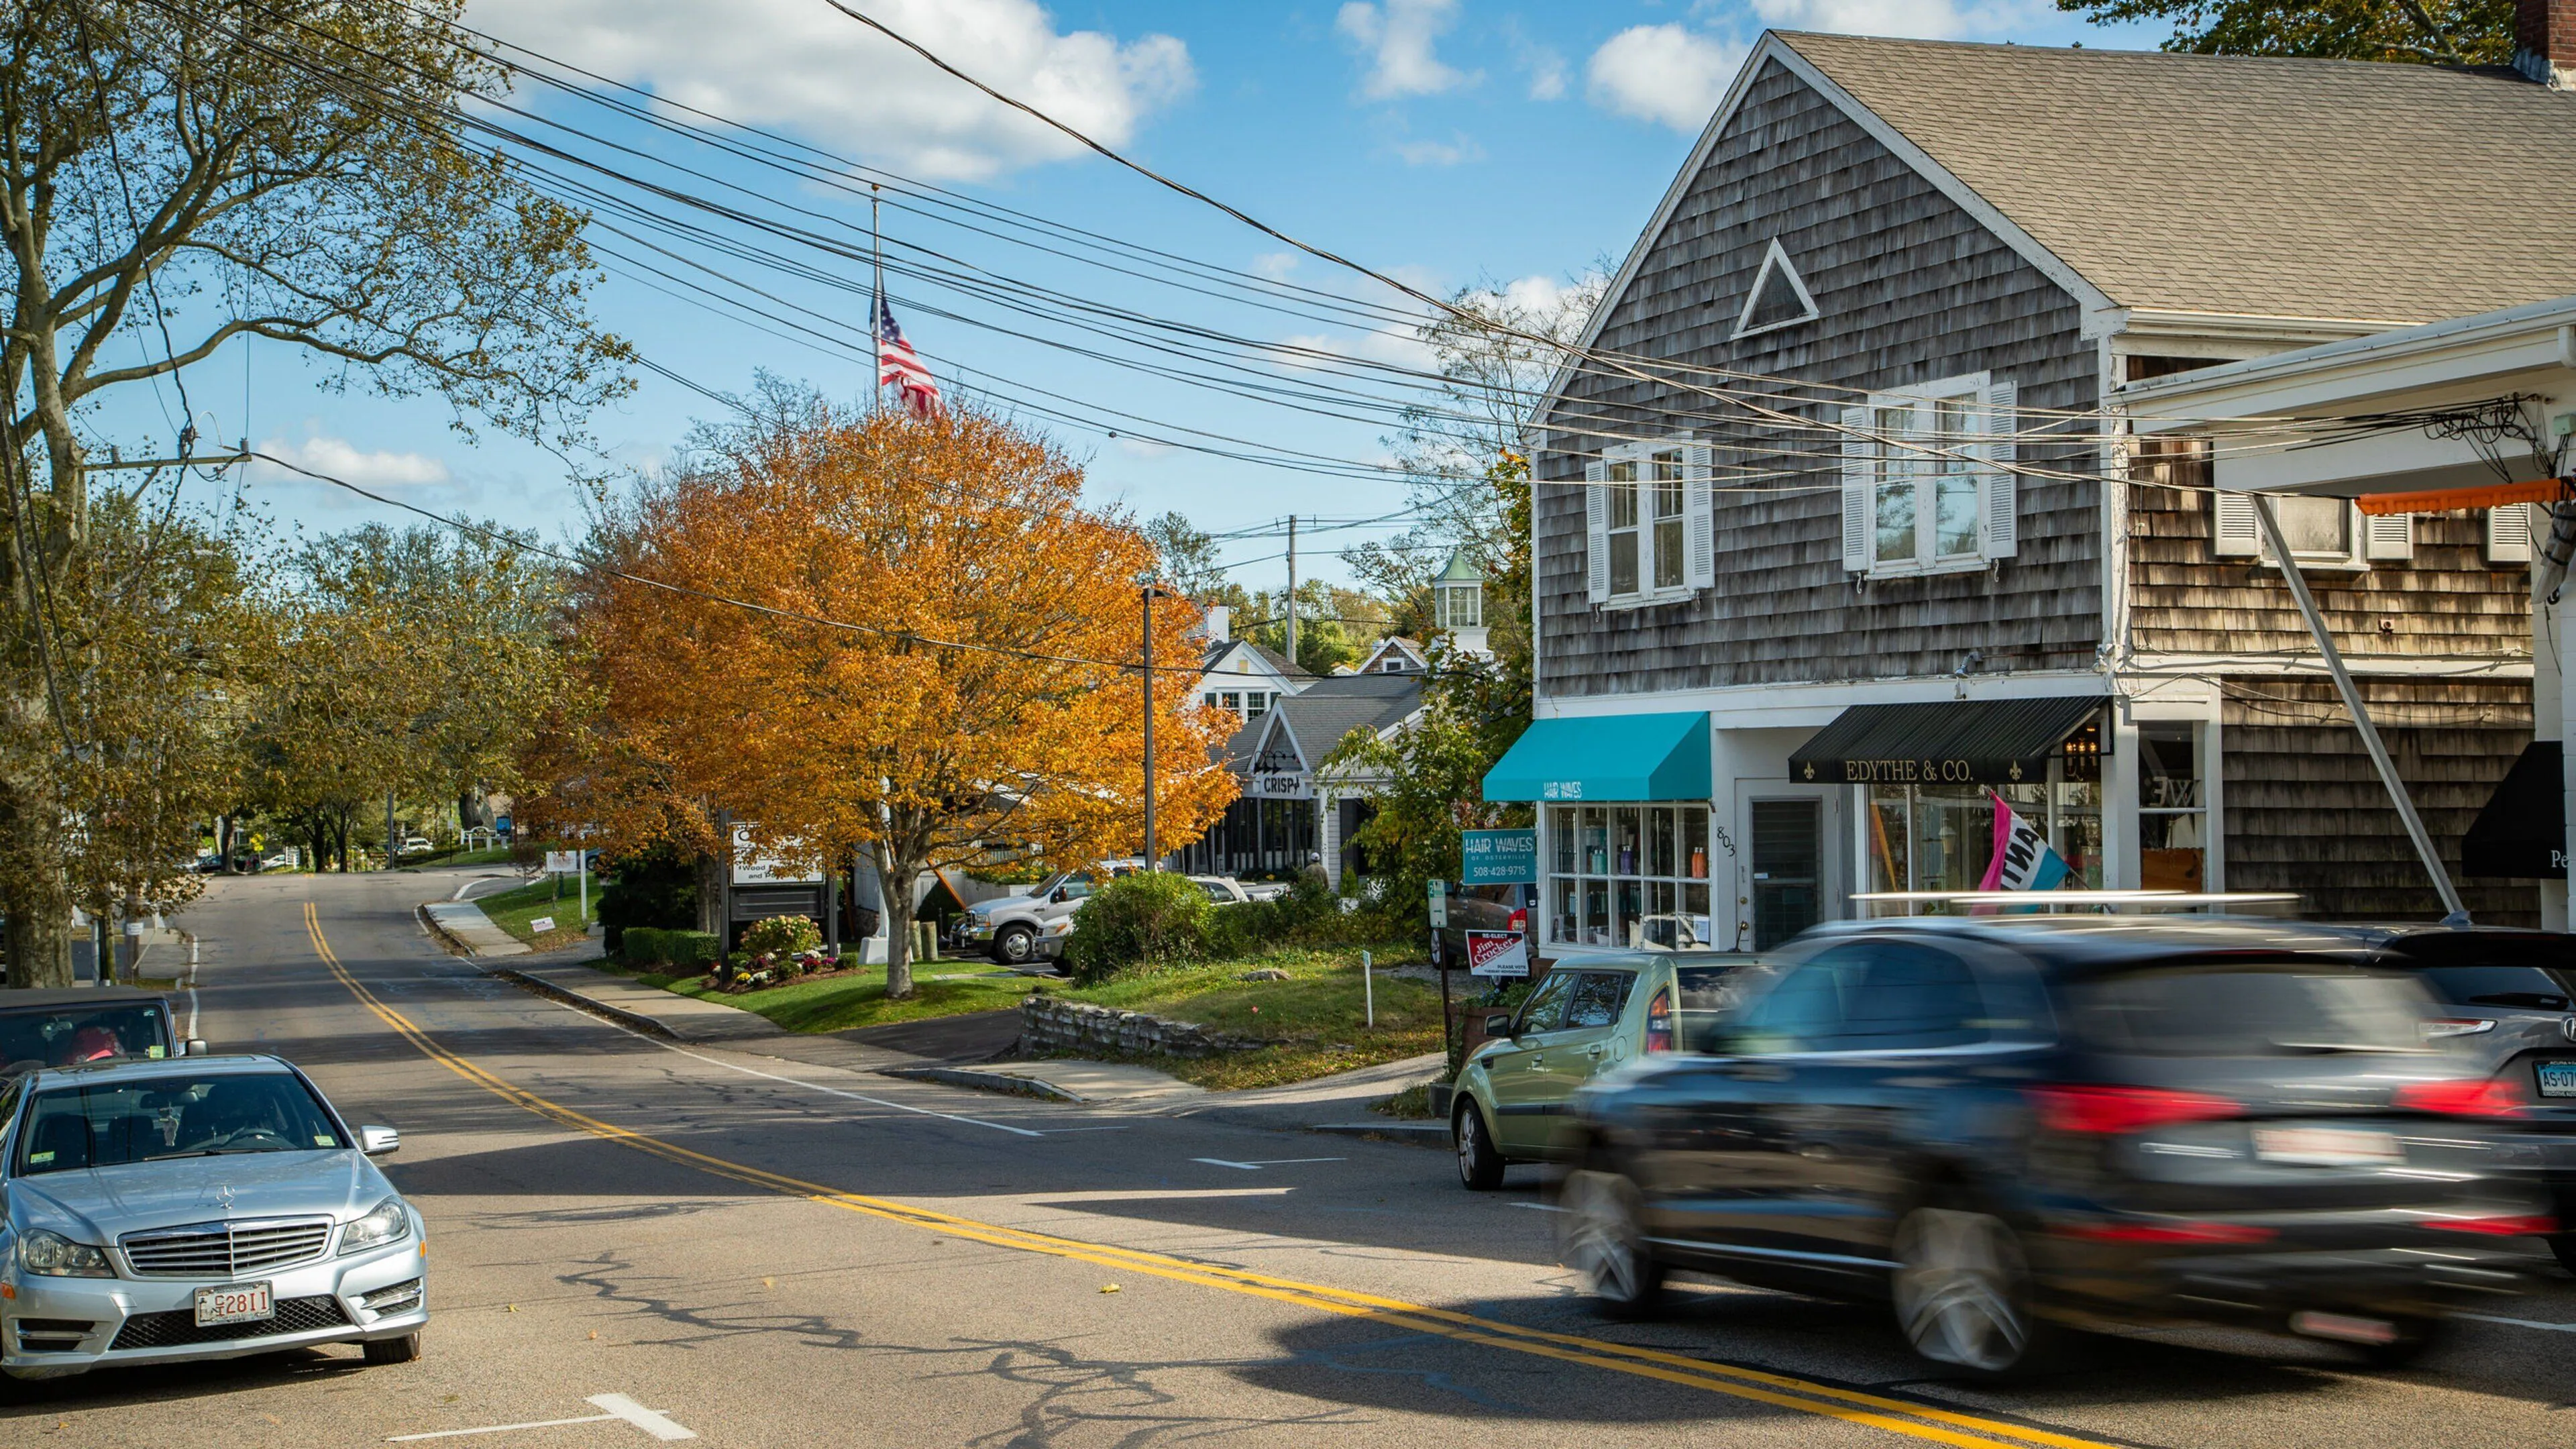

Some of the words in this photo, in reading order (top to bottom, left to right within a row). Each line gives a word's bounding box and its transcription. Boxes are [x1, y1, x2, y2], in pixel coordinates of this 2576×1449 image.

[1845, 760, 1918, 781] EDYTHE
[1923, 760, 1938, 781] &
[1943, 759, 1974, 782] CO.
[1544, 782, 1558, 798] HAIR
[1560, 782, 1582, 798] WAVES
[1465, 838, 1491, 853] HAIR
[1495, 837, 1534, 853] WAVES
[1717, 826, 1735, 857] 803
[1473, 865, 1526, 877] 508-428-9715
[1474, 938, 1513, 964] Crocker
[1477, 941, 1494, 955] Jim
